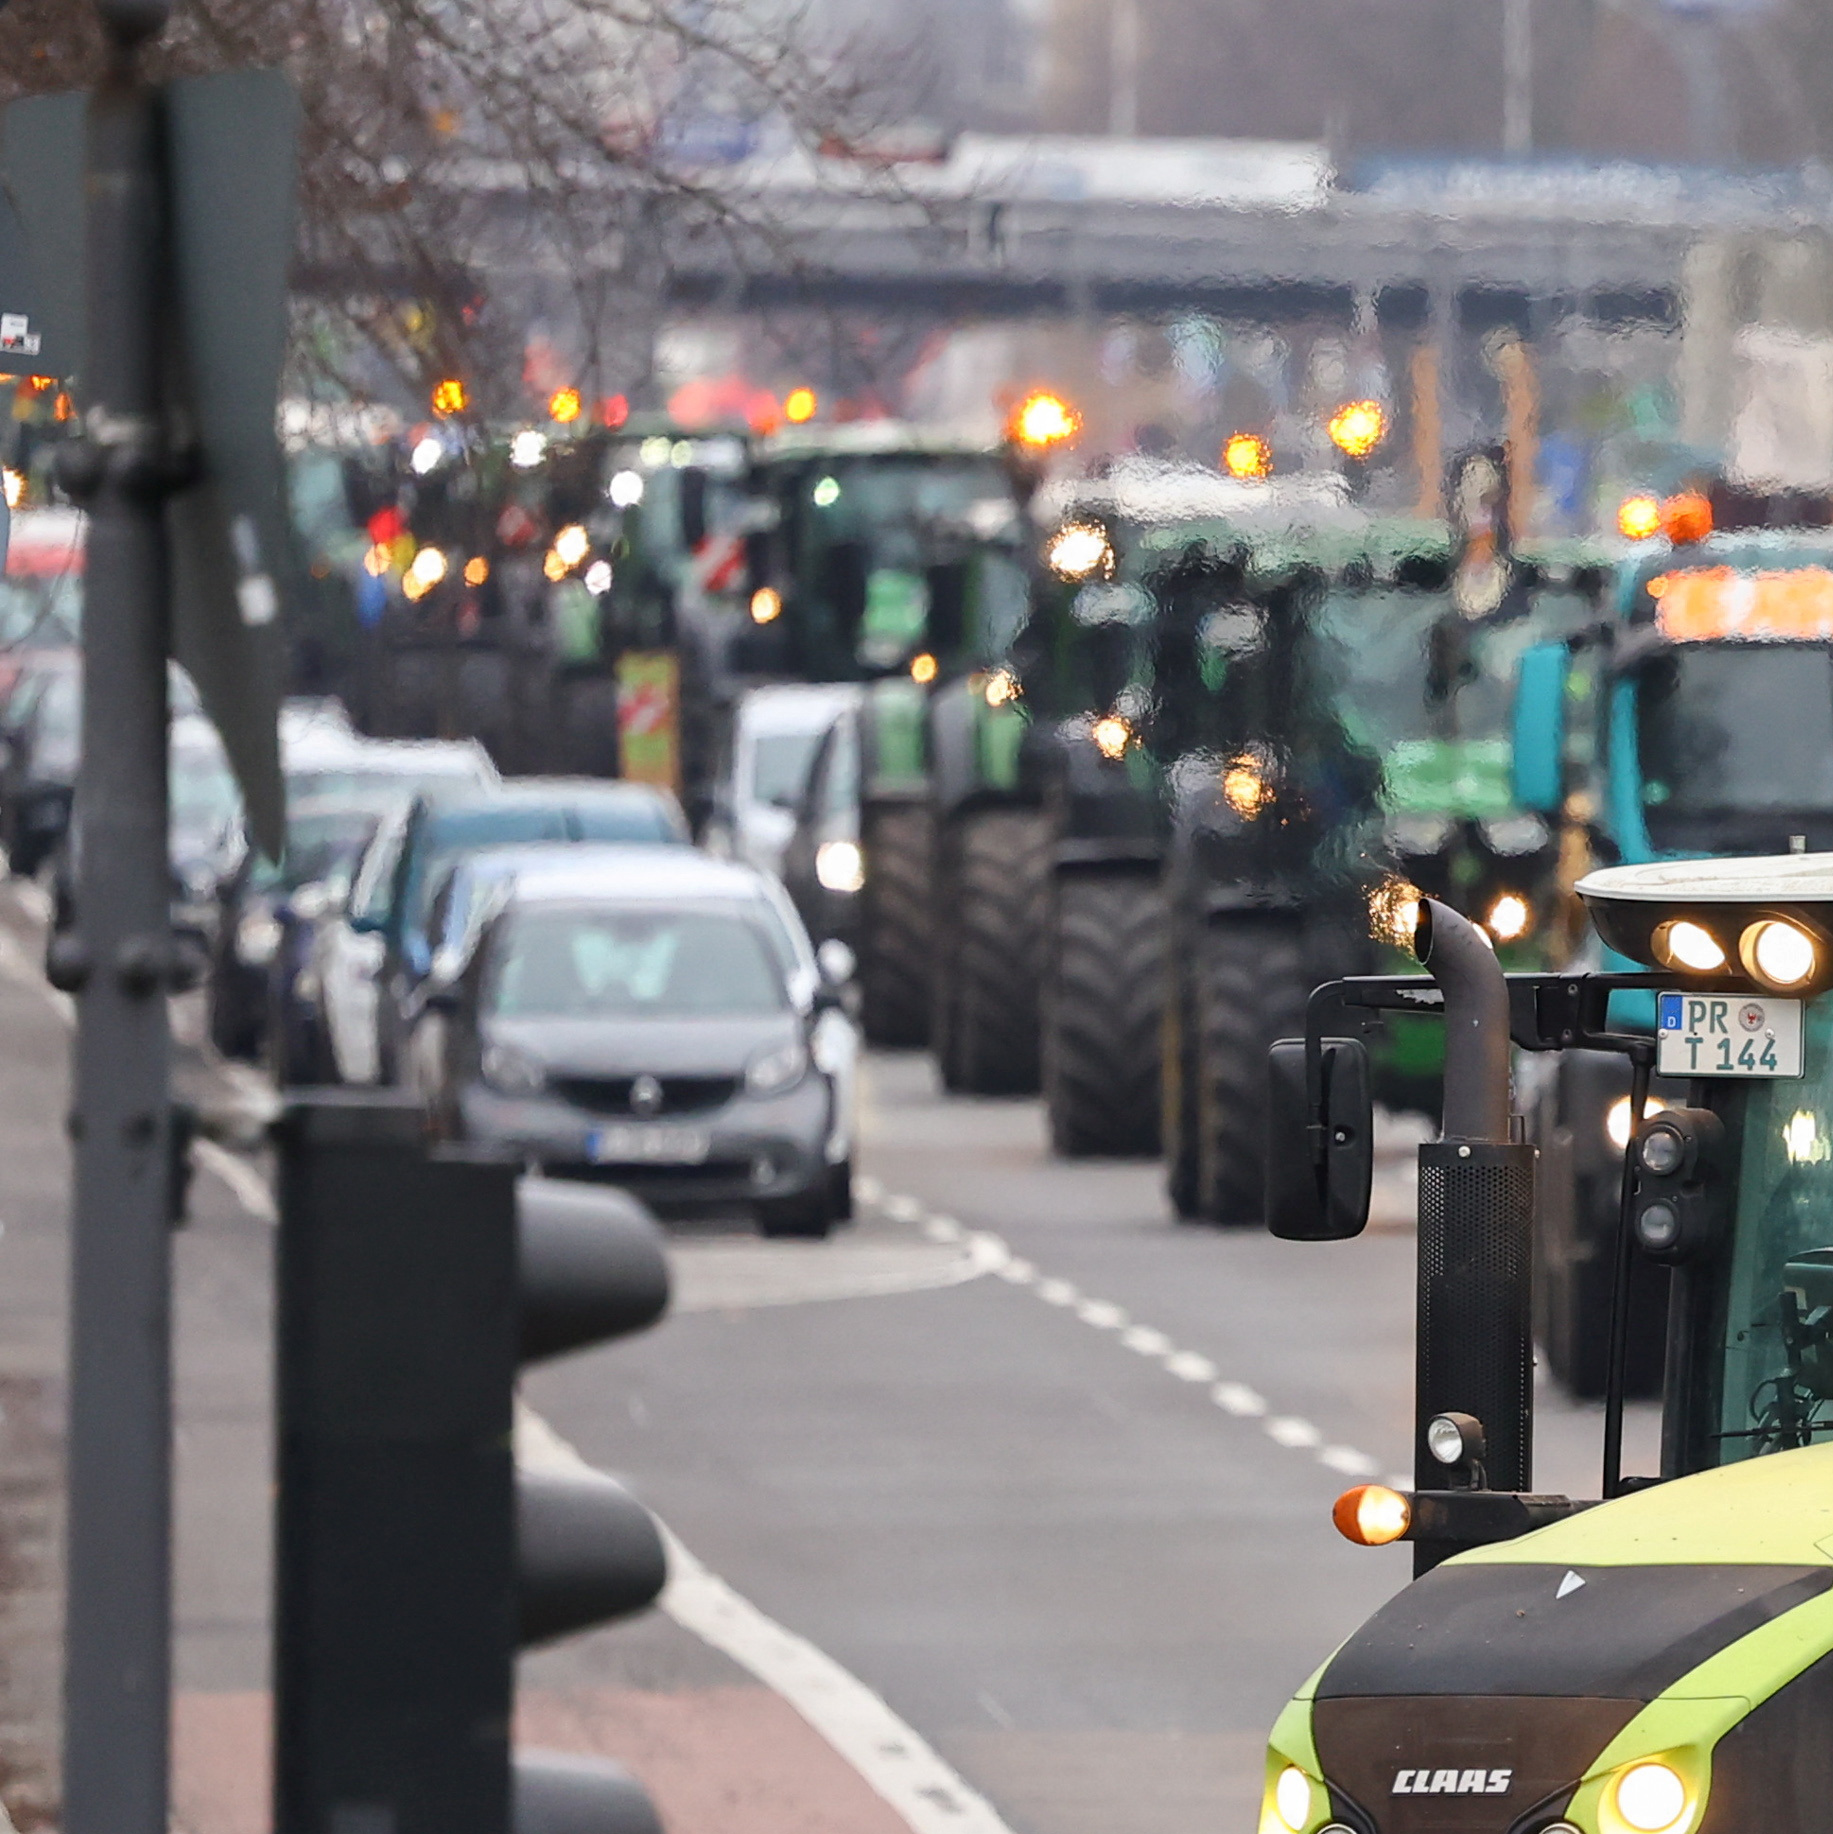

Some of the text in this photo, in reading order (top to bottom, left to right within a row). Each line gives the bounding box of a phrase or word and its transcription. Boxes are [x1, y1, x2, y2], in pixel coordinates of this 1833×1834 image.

[1687, 1001, 1729, 1034] PR
[1684, 1037, 1778, 1071] T 144
[1391, 1769, 1513, 1794] CLAAS
